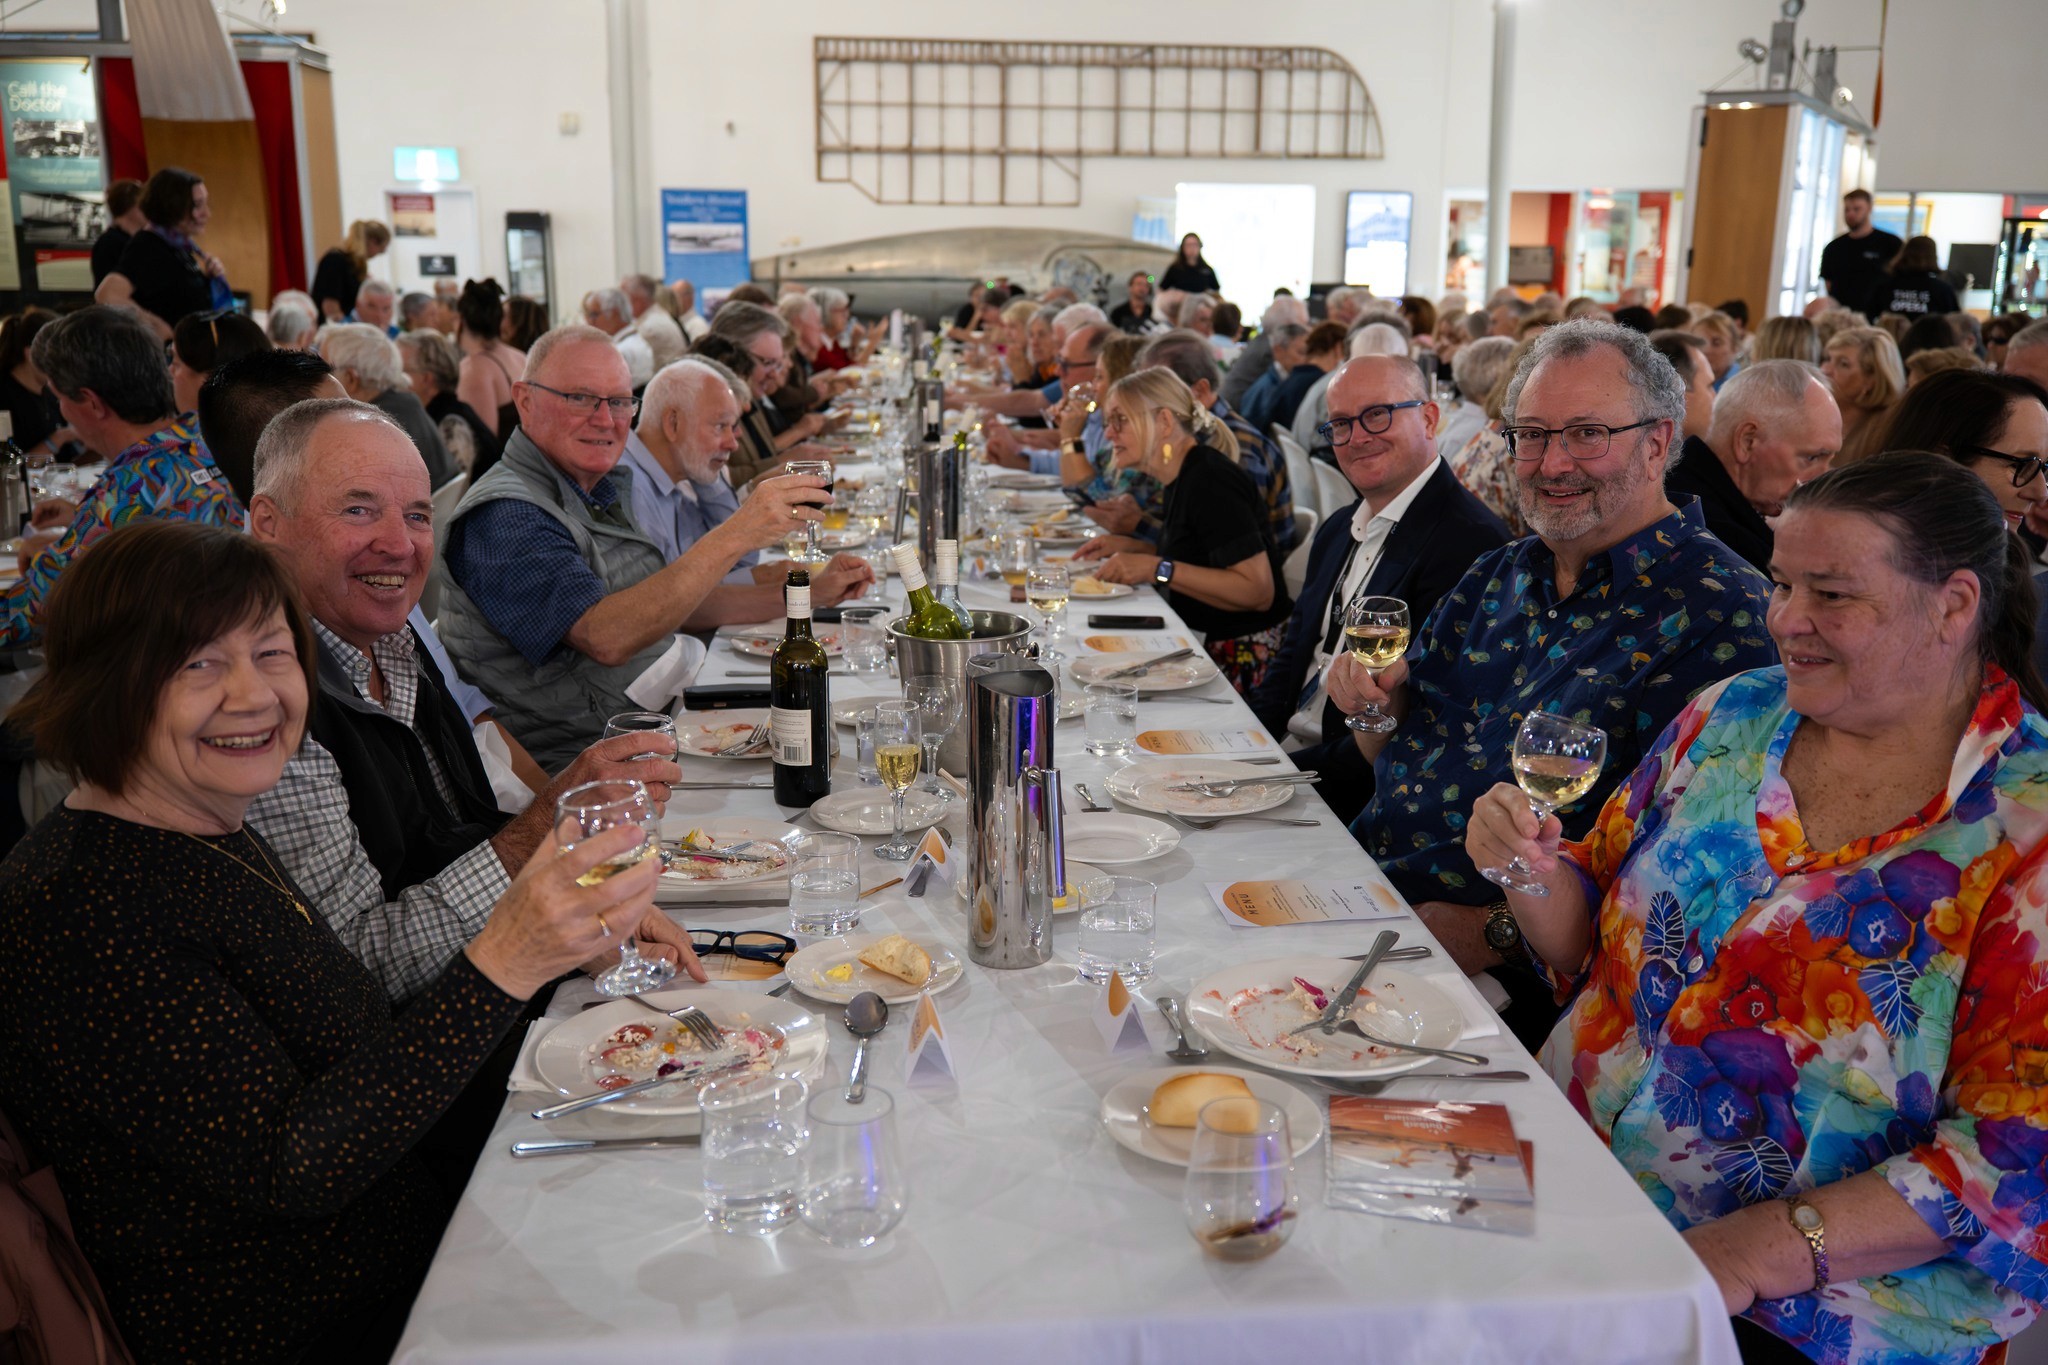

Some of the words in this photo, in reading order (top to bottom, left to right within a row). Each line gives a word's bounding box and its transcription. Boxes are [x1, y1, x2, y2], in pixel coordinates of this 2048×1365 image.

[8, 80, 37, 97] Call
[41, 80, 67, 97] the
[9, 98, 61, 112] Doctor
[1239, 893, 1260, 915] MENU
